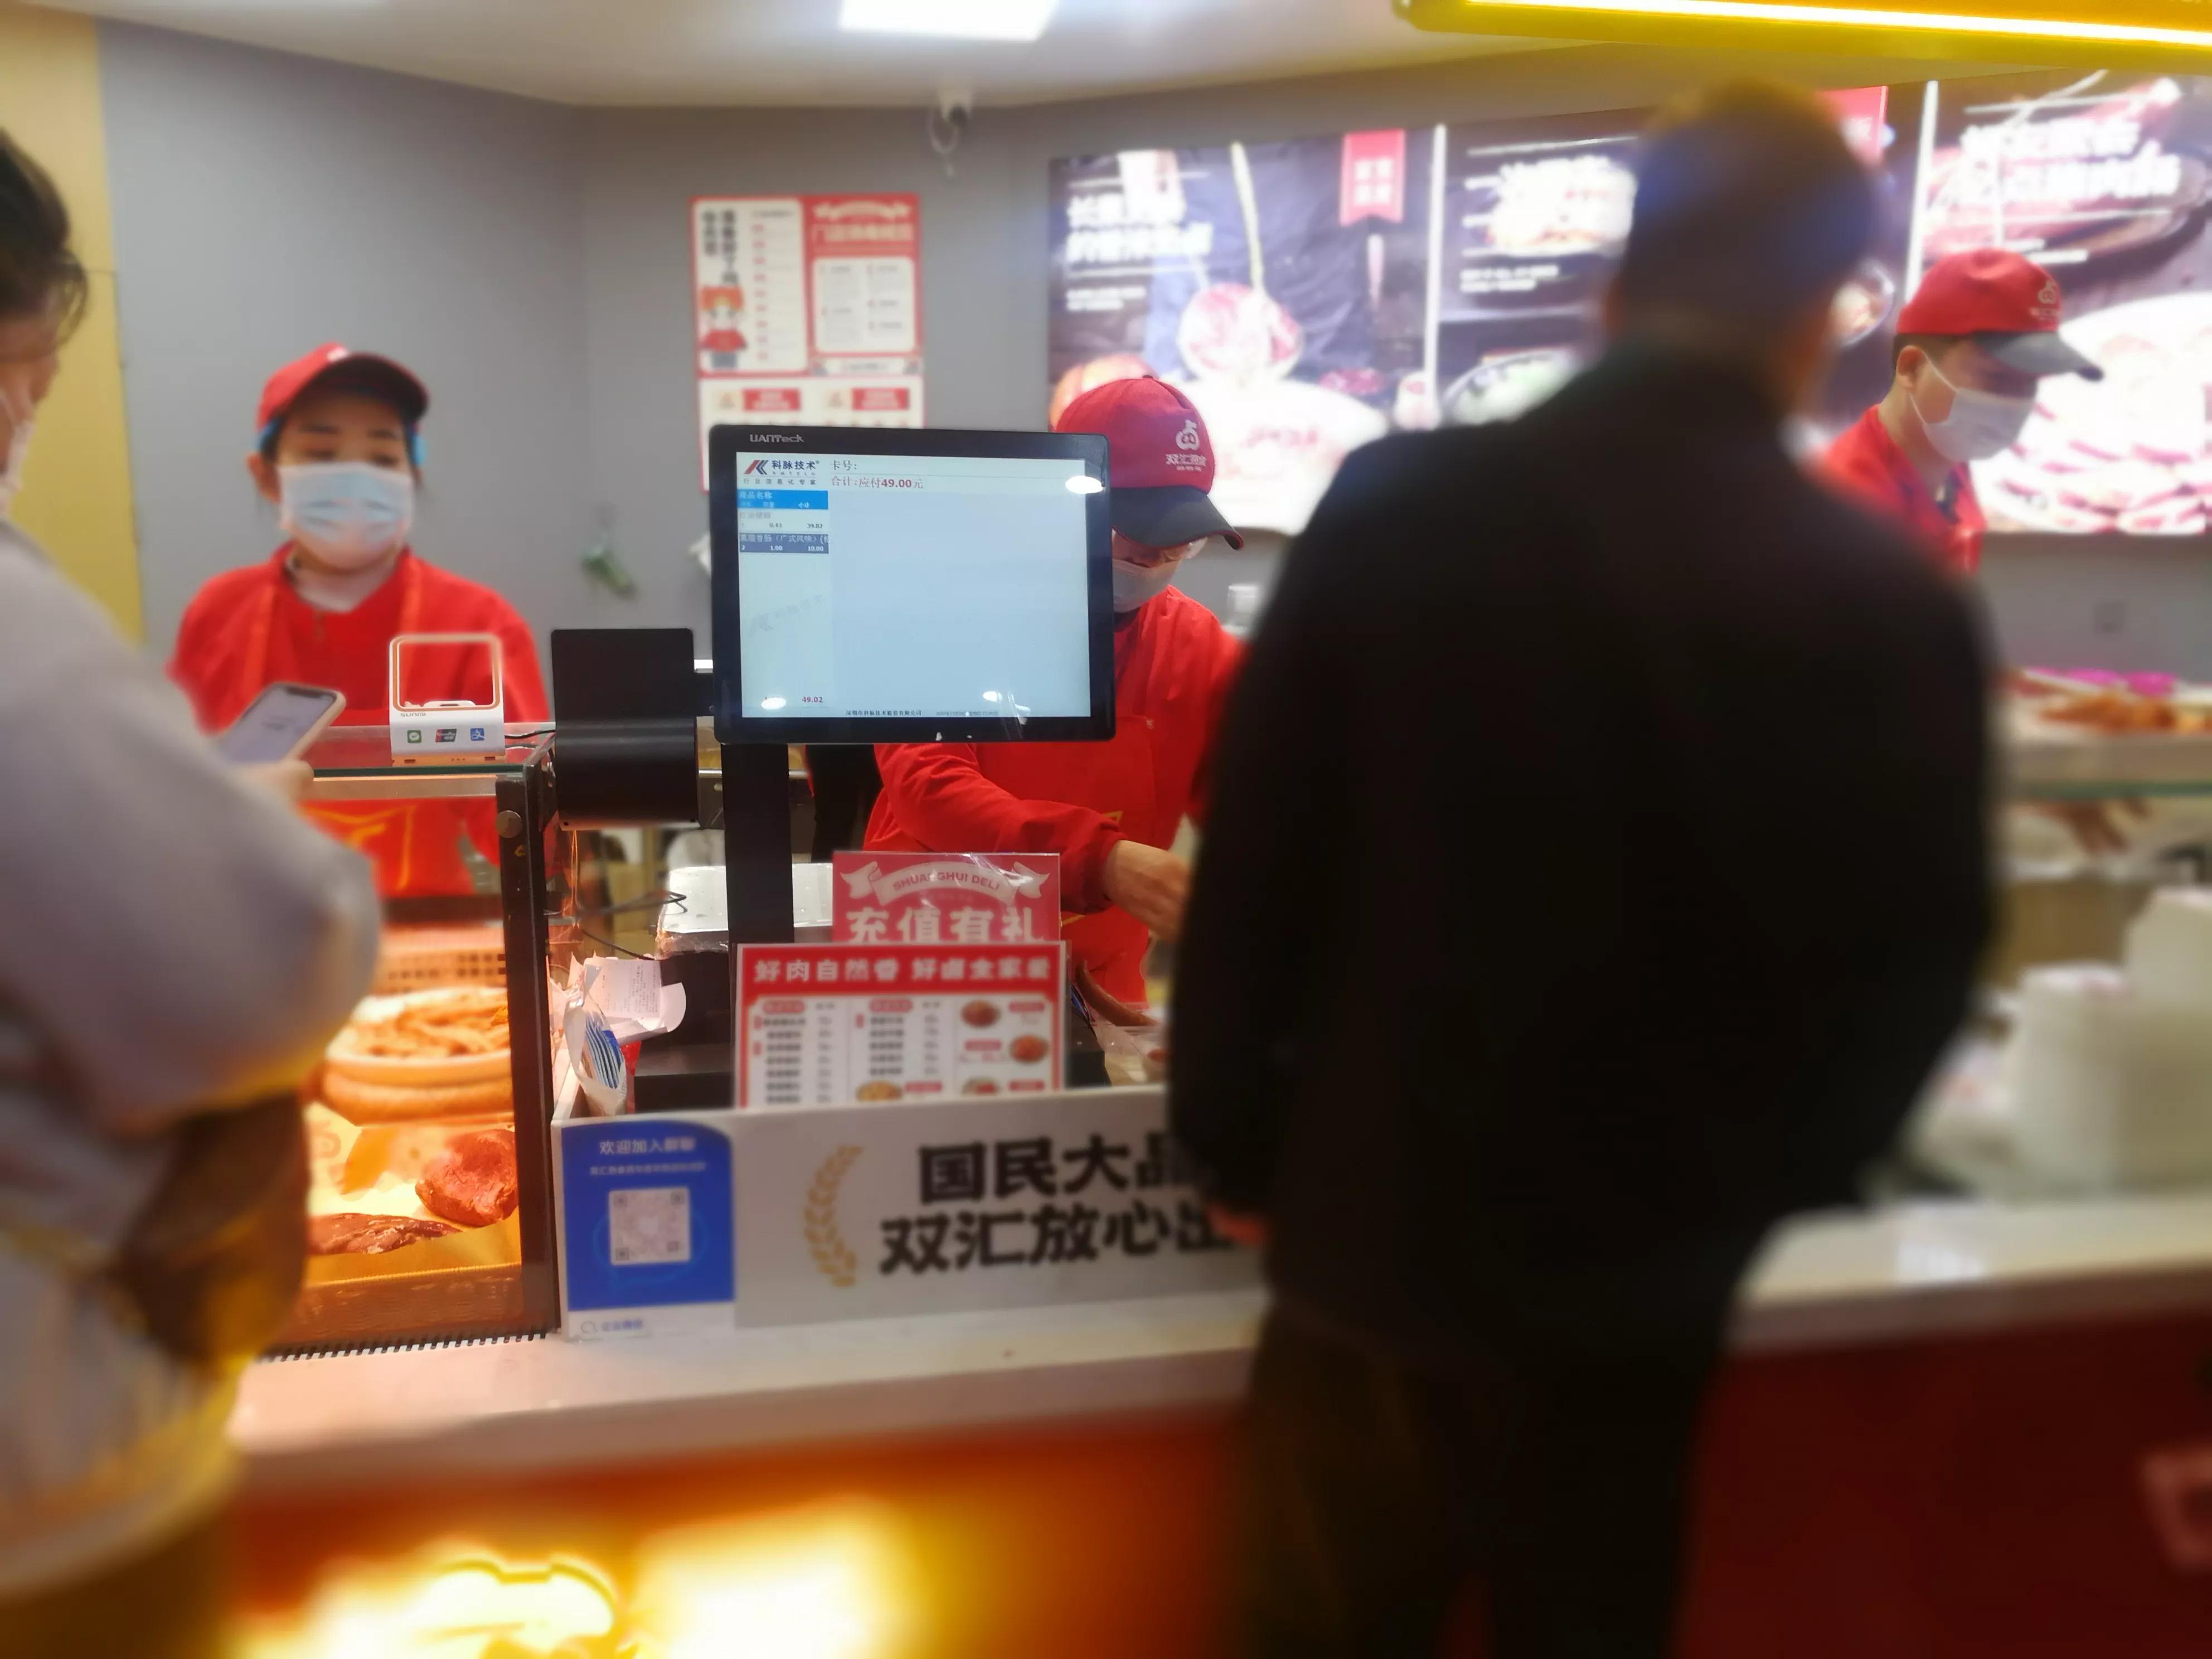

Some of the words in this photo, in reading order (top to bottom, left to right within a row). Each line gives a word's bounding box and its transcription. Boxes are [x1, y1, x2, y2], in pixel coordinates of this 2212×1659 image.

[772, 460, 816, 470] 科脉技术
[971, 874, 1001, 891] DELI
[845, 906, 1044, 943] 充值有礼
